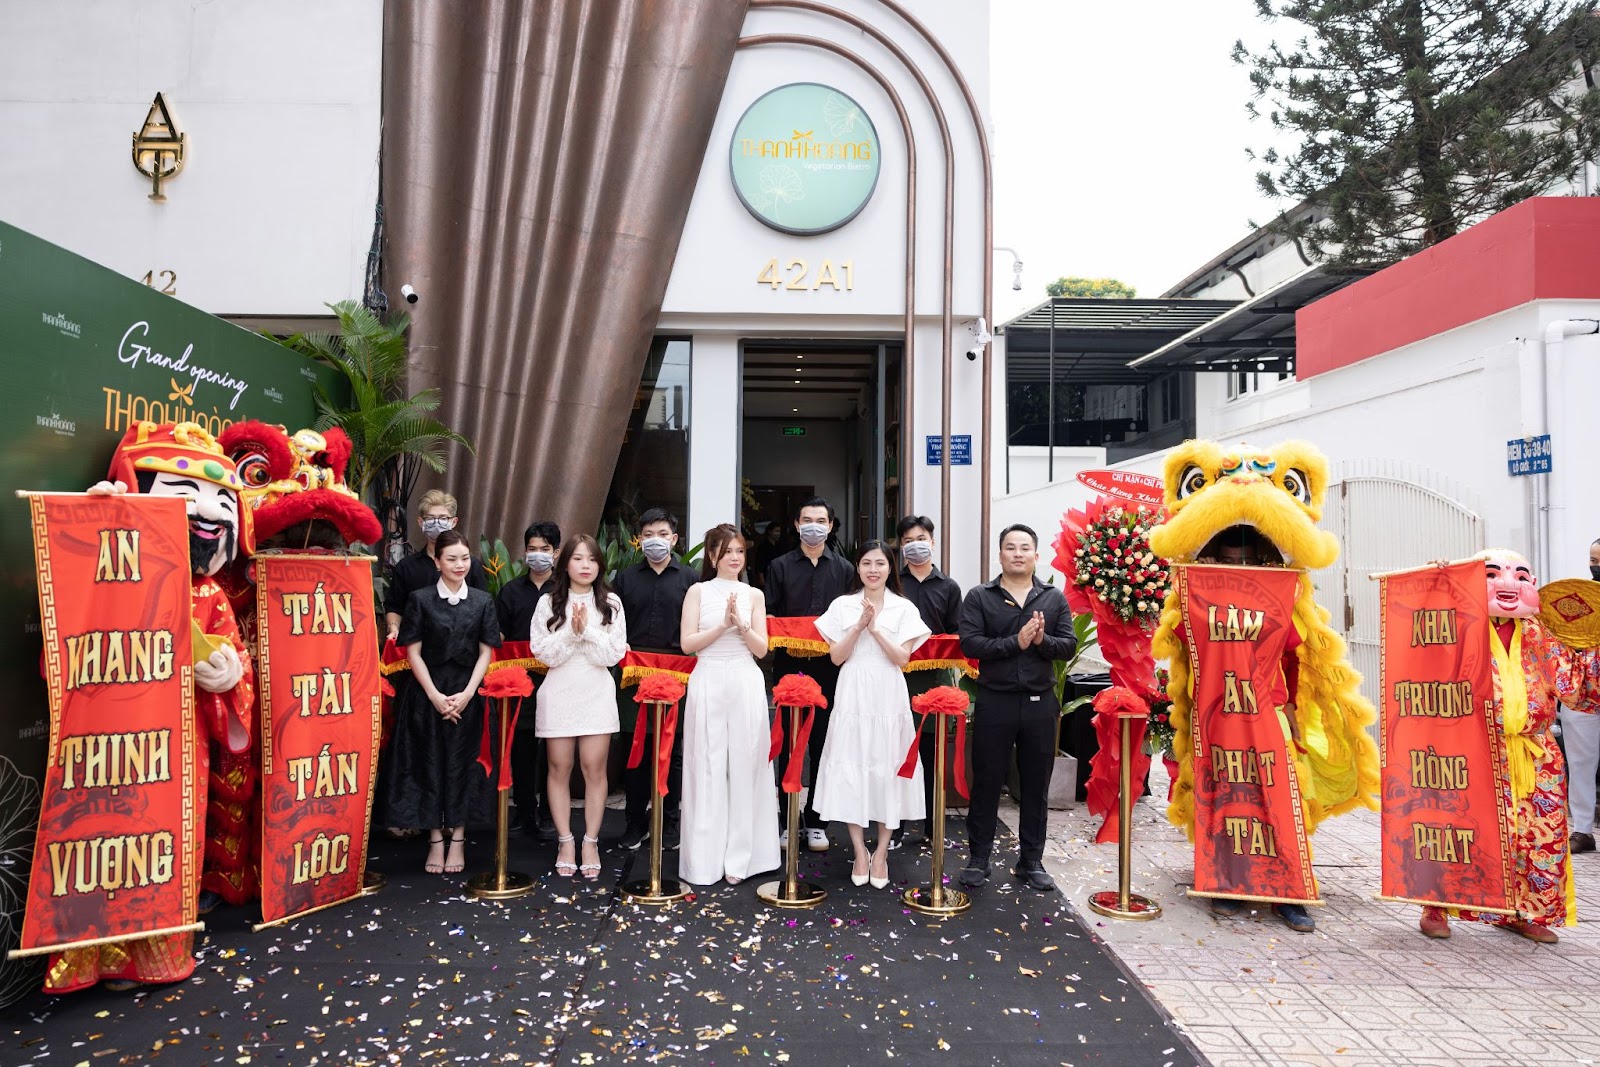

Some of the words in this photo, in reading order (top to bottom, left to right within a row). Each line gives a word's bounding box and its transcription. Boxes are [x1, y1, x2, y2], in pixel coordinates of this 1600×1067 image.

[757, 256, 853, 291] 42A1
[118, 321, 193, 372] Grand
[190, 364, 248, 410] opening
[95, 529, 141, 583] AN
[281, 582, 355, 636] TẤN
[1208, 604, 1265, 642] LÀM
[1411, 608, 1459, 648] KHAI
[65, 629, 175, 691] KHANG
[292, 671, 354, 717] TÀI
[1223, 670, 1259, 714] ĂN
[1394, 680, 1474, 718] TRƯƠNG
[59, 729, 172, 796] THỊNH
[287, 743, 359, 802] TẤN
[1210, 744, 1276, 787] PHÁT
[1409, 745, 1470, 791] HỒNG
[291, 832, 351, 887] LỘC
[1224, 816, 1278, 858] TÀI
[1412, 821, 1475, 865] PHÁT
[47, 830, 175, 900] VƯỢNG
